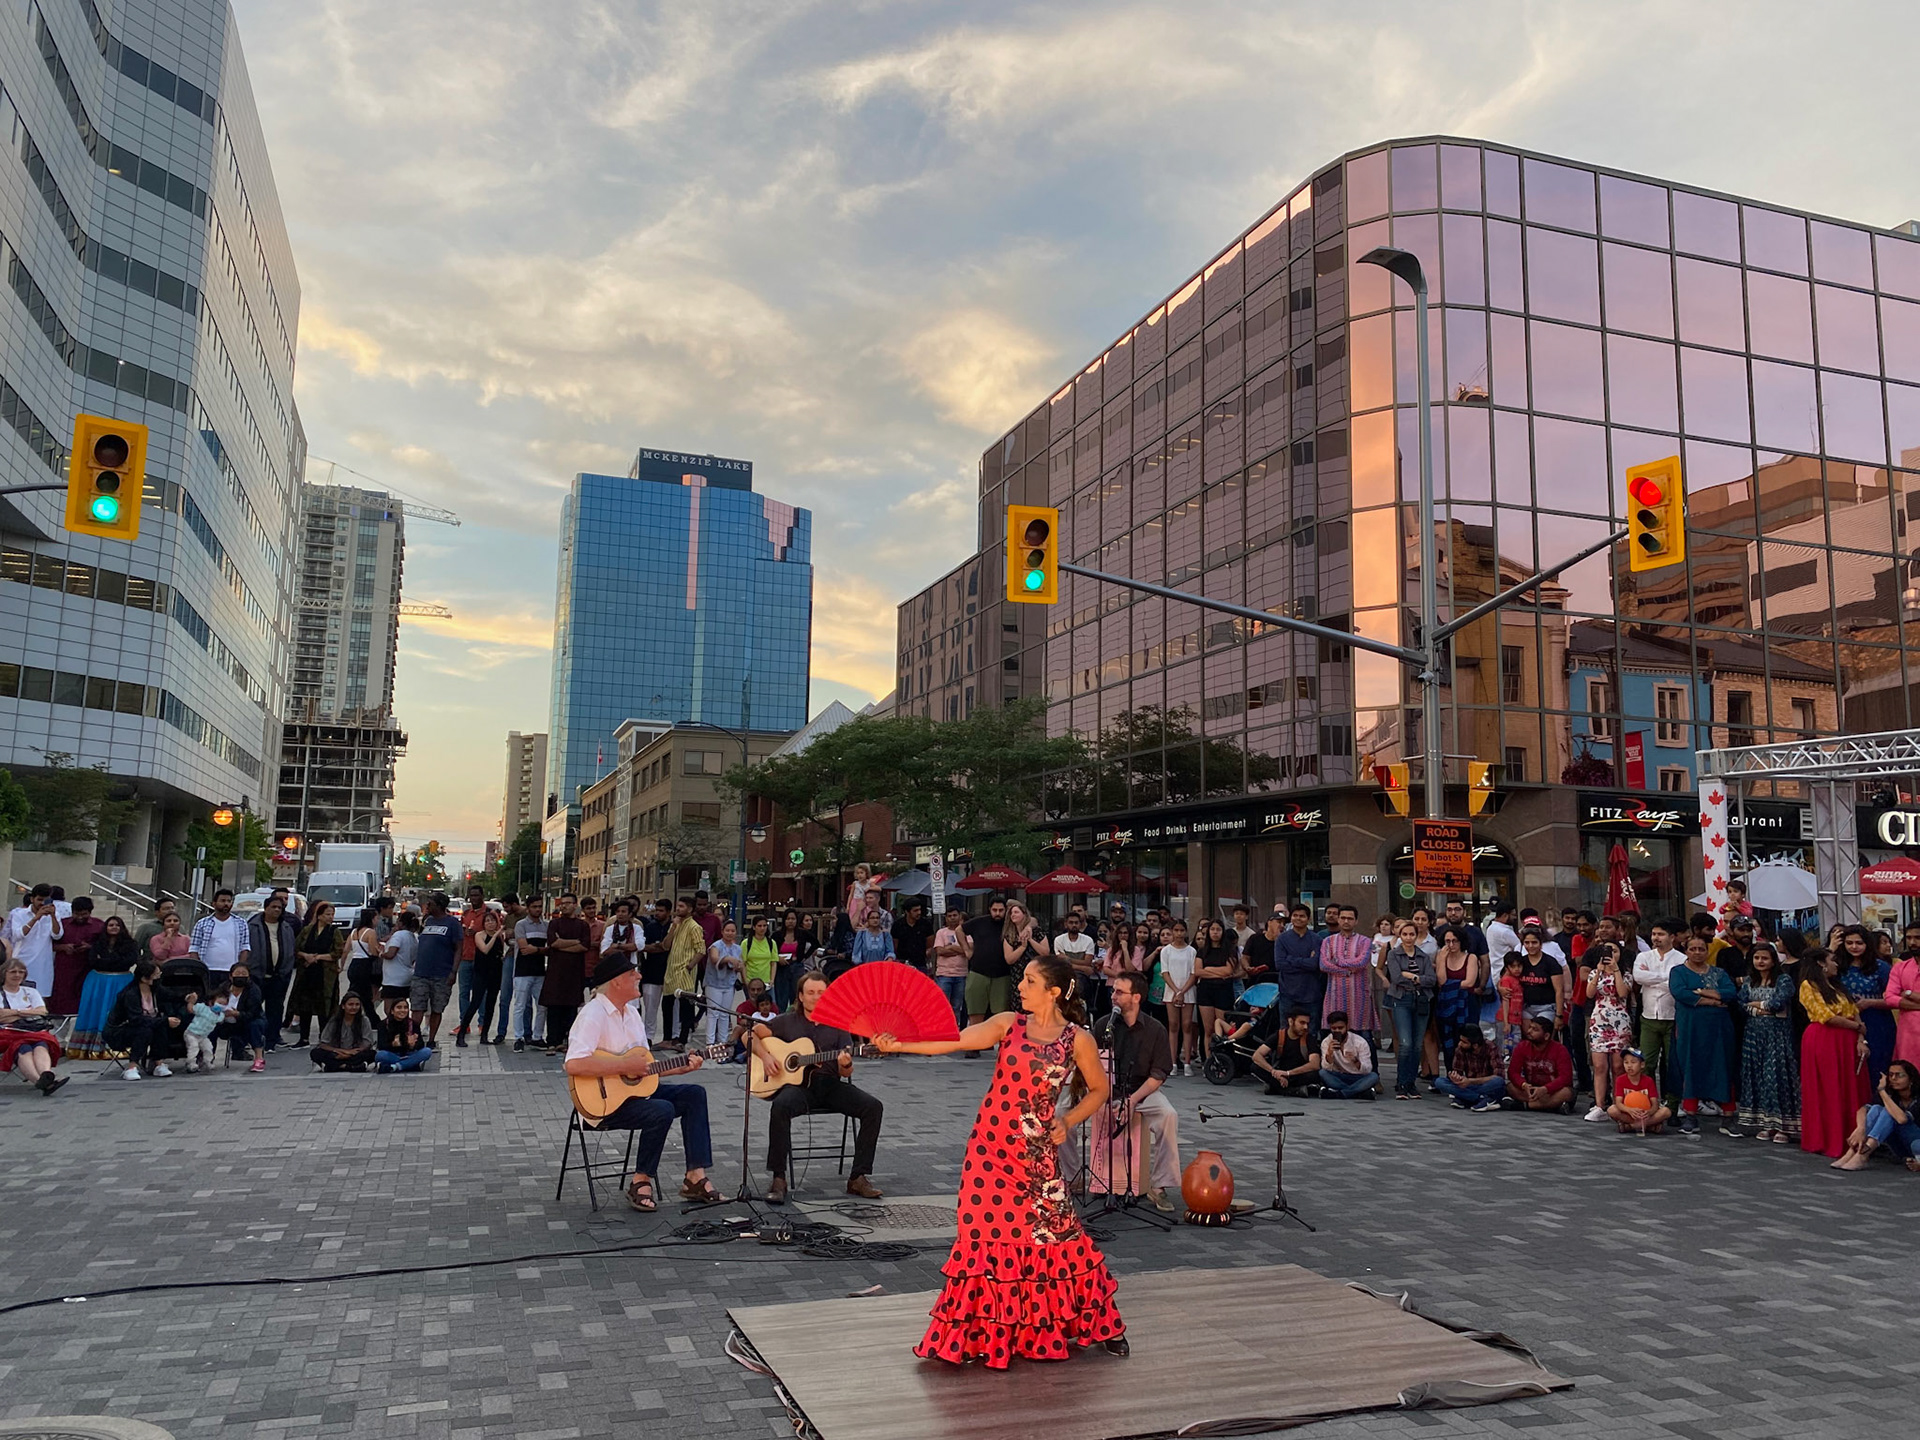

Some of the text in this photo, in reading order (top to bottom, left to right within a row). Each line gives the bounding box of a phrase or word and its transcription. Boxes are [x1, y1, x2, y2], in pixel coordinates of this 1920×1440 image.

[717, 460, 749, 471] LAKE
[1144, 818, 1247, 837] Food Drinks Entertainment
[1426, 827, 1459, 838] ROAD
[1420, 839, 1465, 850] CLOSED
[1425, 853, 1462, 862] Talbot St
